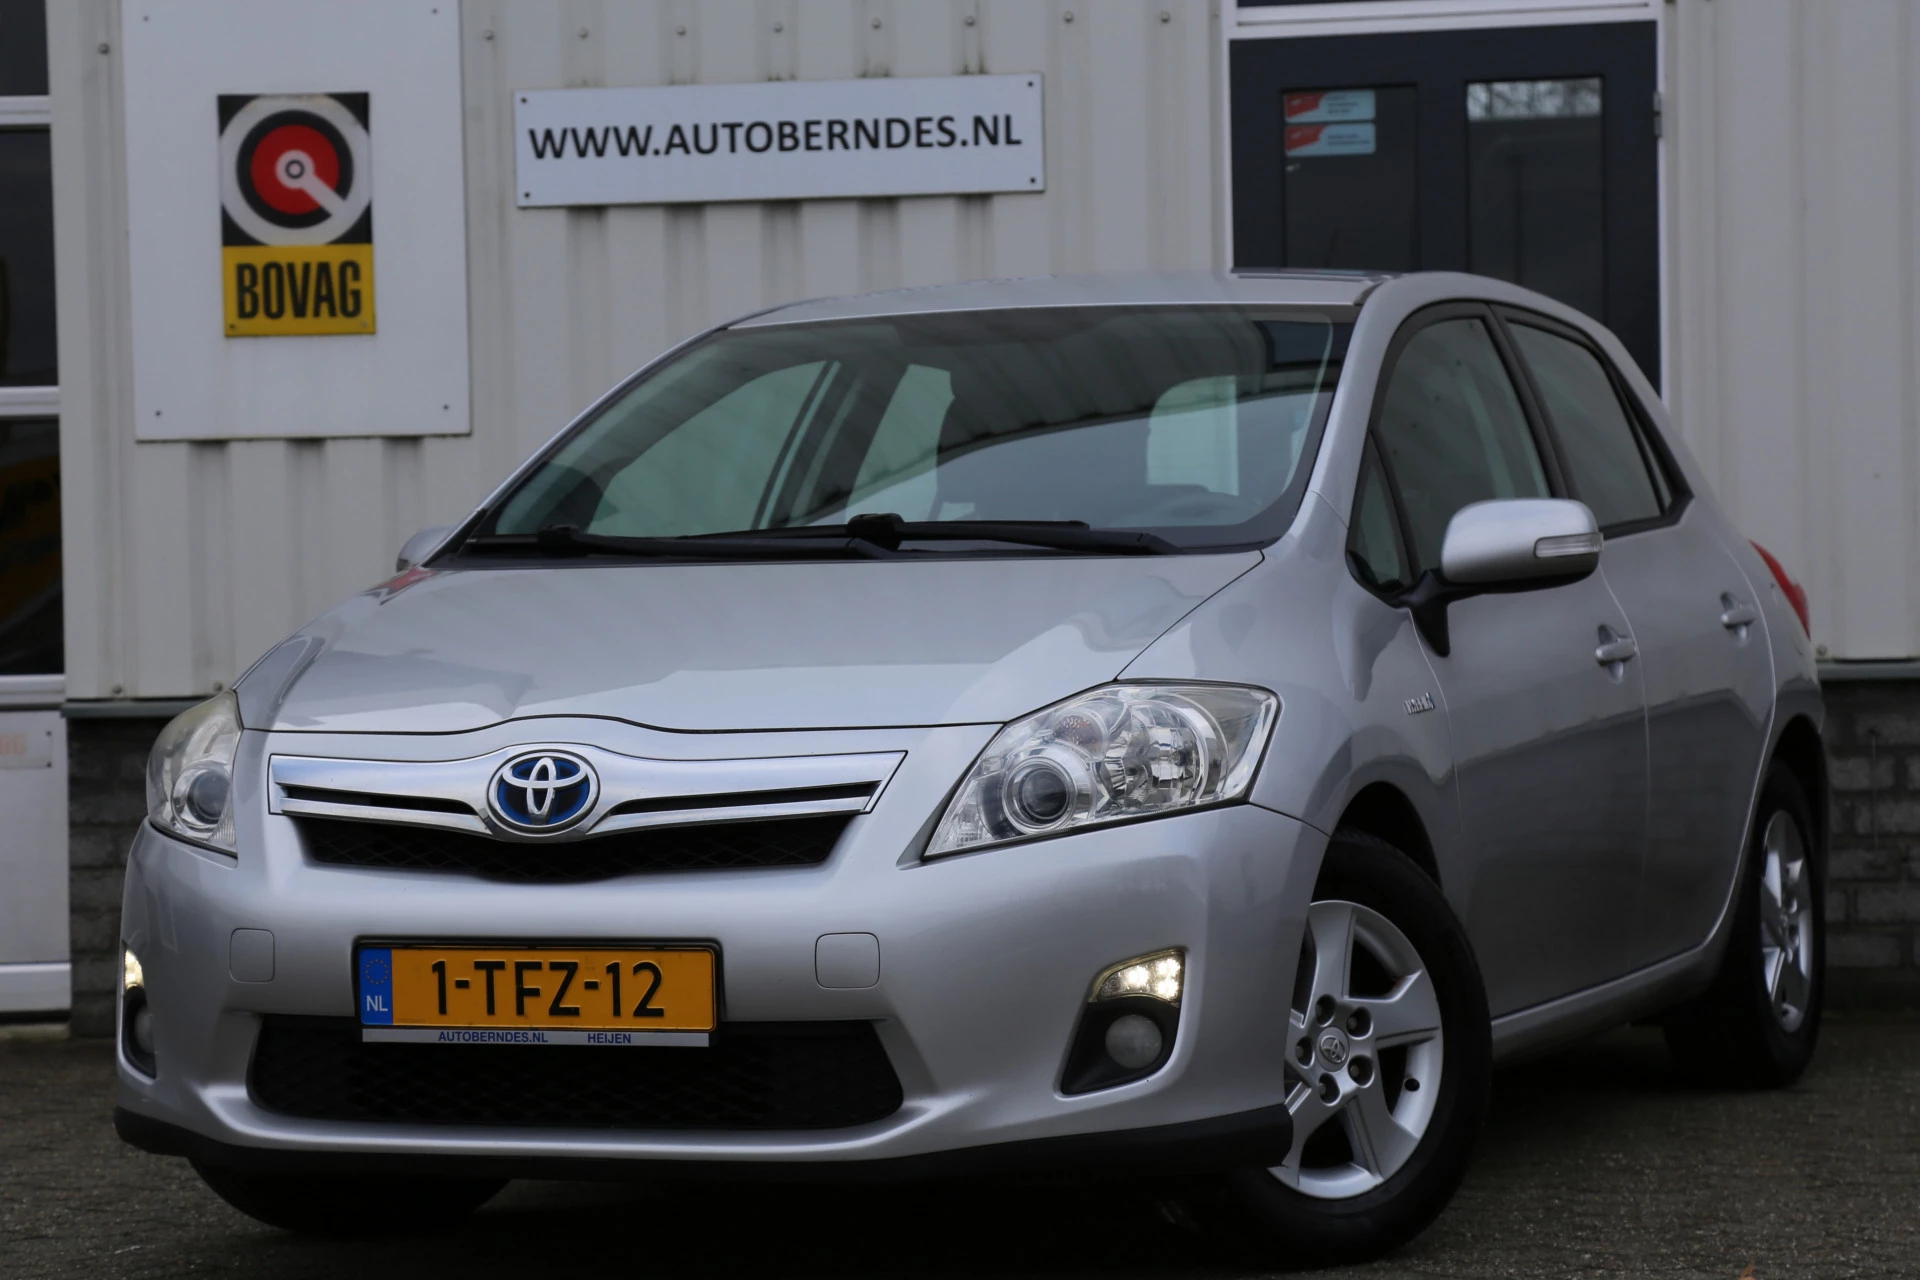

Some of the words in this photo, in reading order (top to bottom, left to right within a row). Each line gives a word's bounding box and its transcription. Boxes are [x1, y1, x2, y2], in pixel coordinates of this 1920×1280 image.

[528, 114, 1022, 159] WWW.AUTOBERNDES.NL
[236, 260, 362, 319] BOVAG
[366, 995, 388, 1012] NL
[431, 959, 665, 1018] 1-TFZ-12
[438, 1031, 548, 1044] AUTOBERNDES.NL
[587, 1032, 632, 1045] HEIJEN
